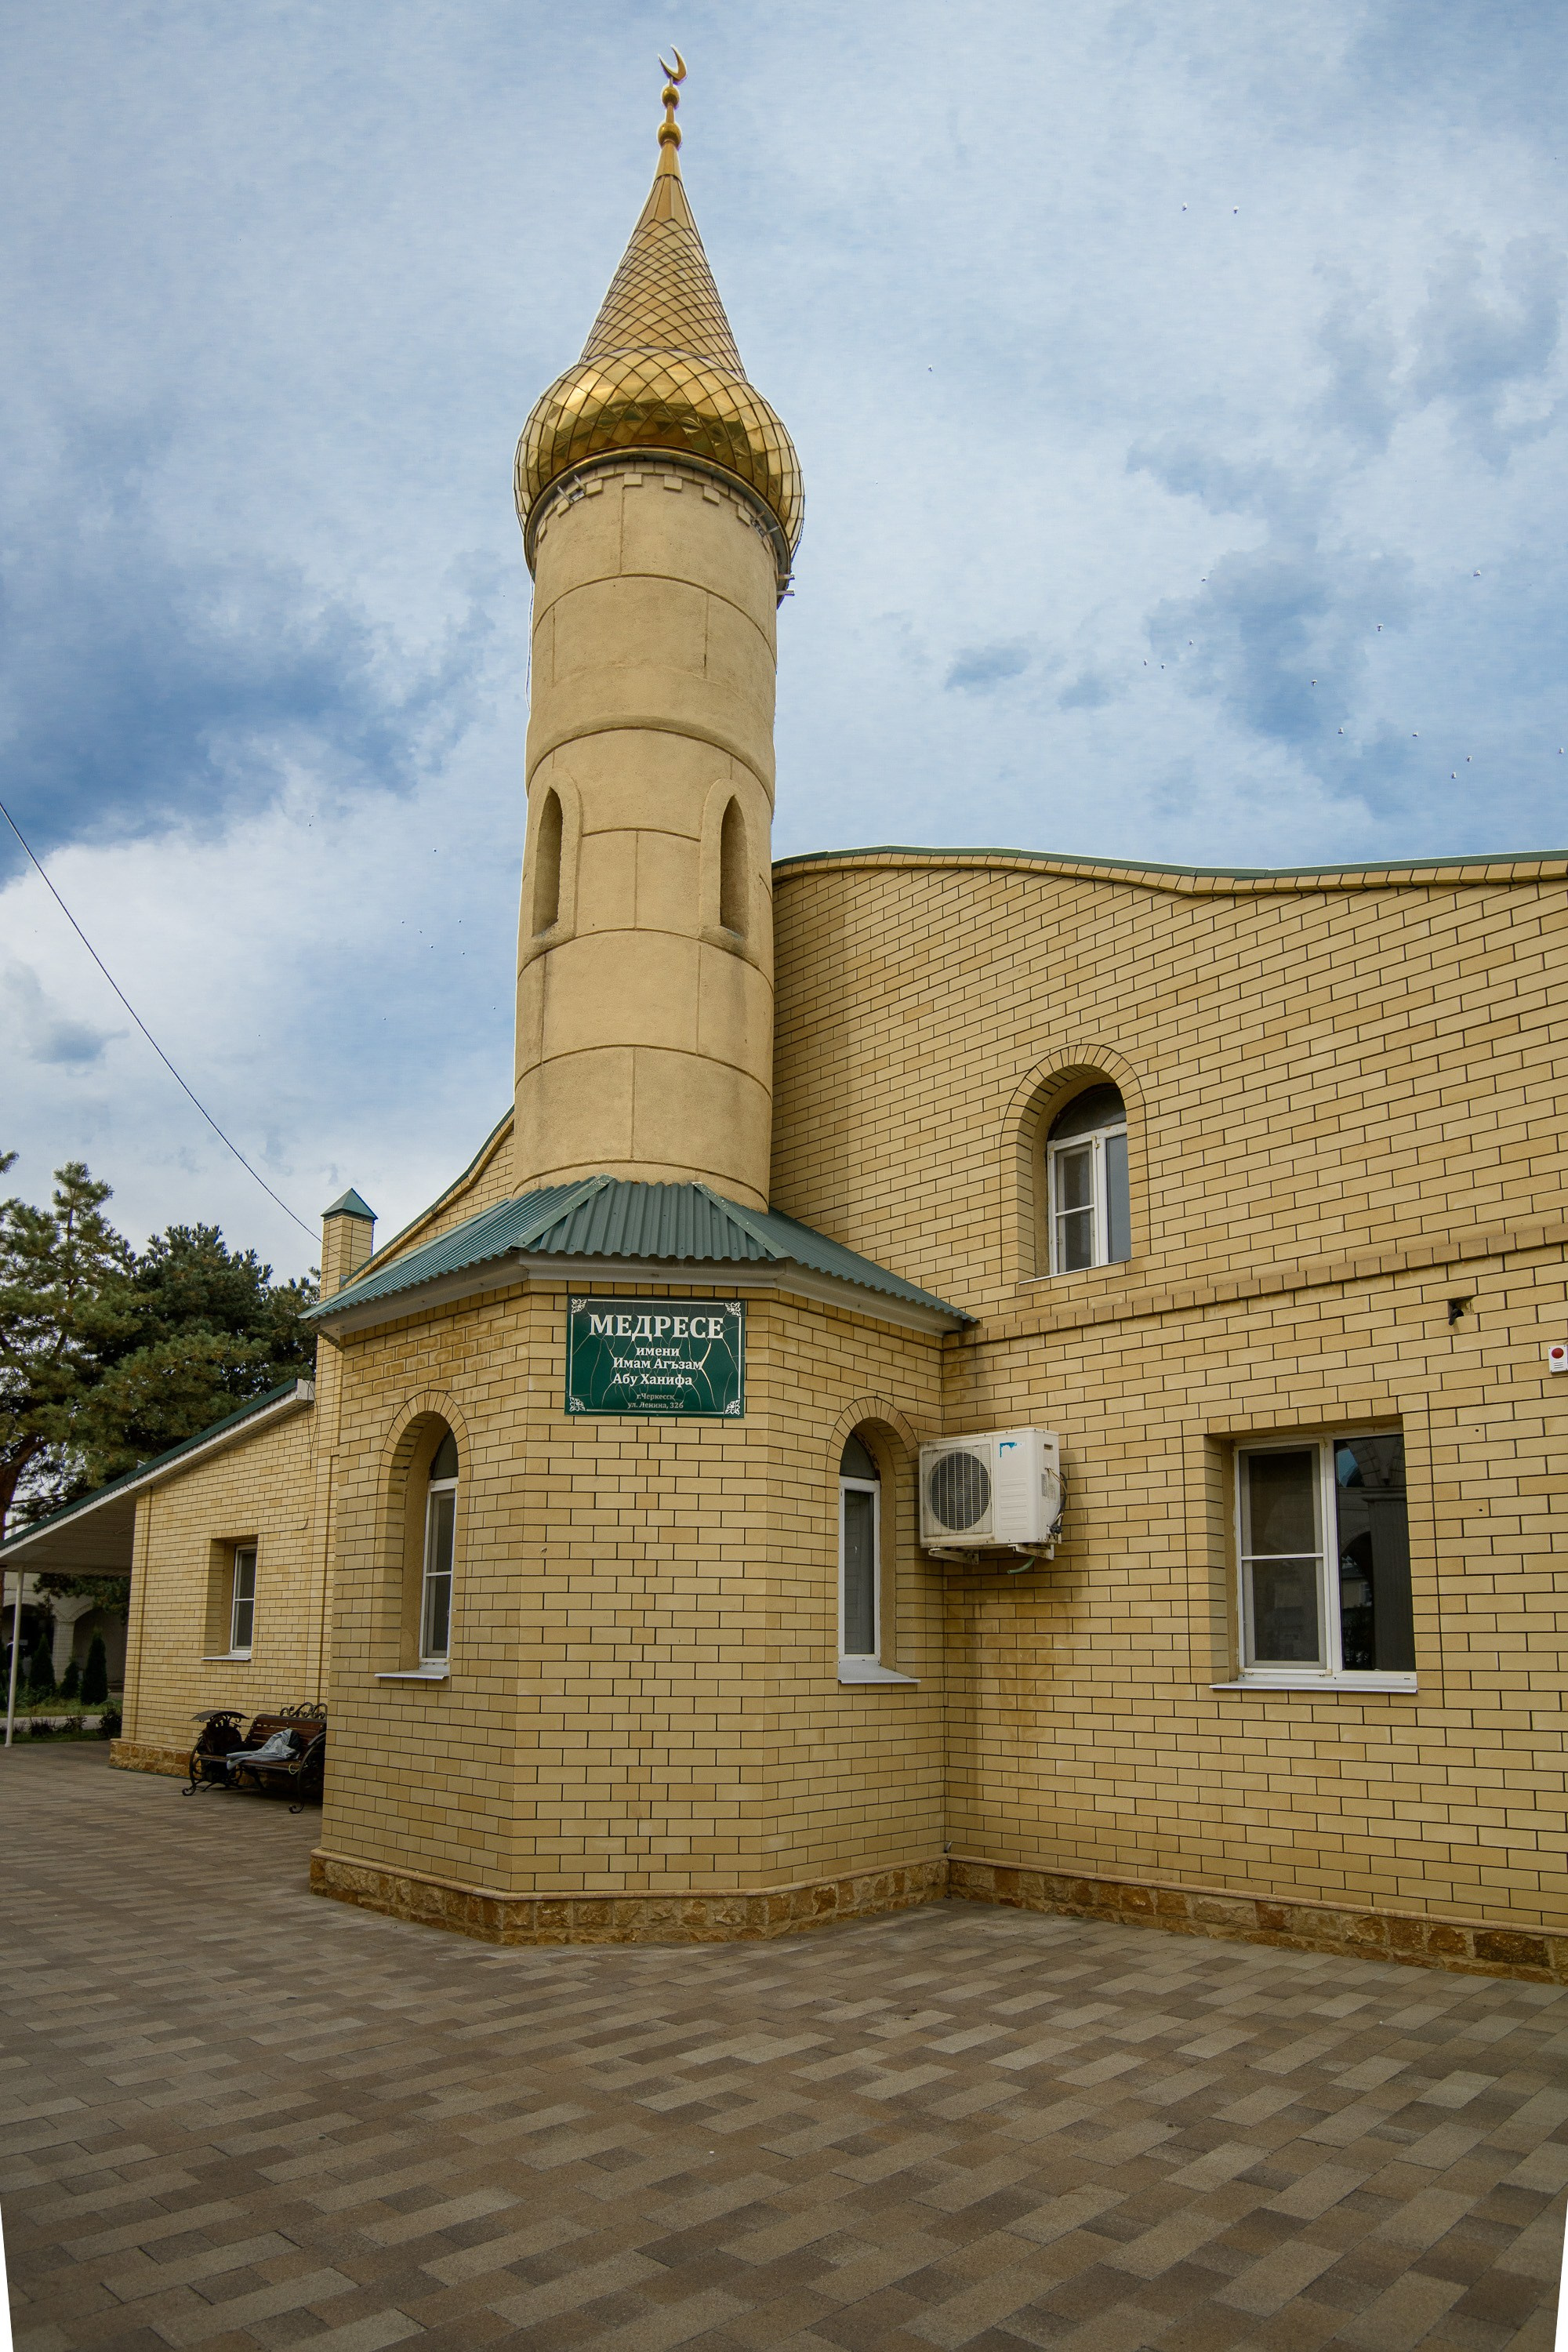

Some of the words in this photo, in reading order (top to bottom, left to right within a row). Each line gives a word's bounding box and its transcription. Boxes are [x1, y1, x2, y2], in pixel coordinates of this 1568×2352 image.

[590, 1314, 724, 1342] МЕДРЕСЕ
[636, 1347, 681, 1356] имени
[613, 1357, 651, 1369] Имам
[654, 1358, 702, 1370] Агъзам
[612, 1374, 638, 1387] Абу
[641, 1374, 692, 1388] Ханифа
[639, 1401, 669, 1410] Ленина,
